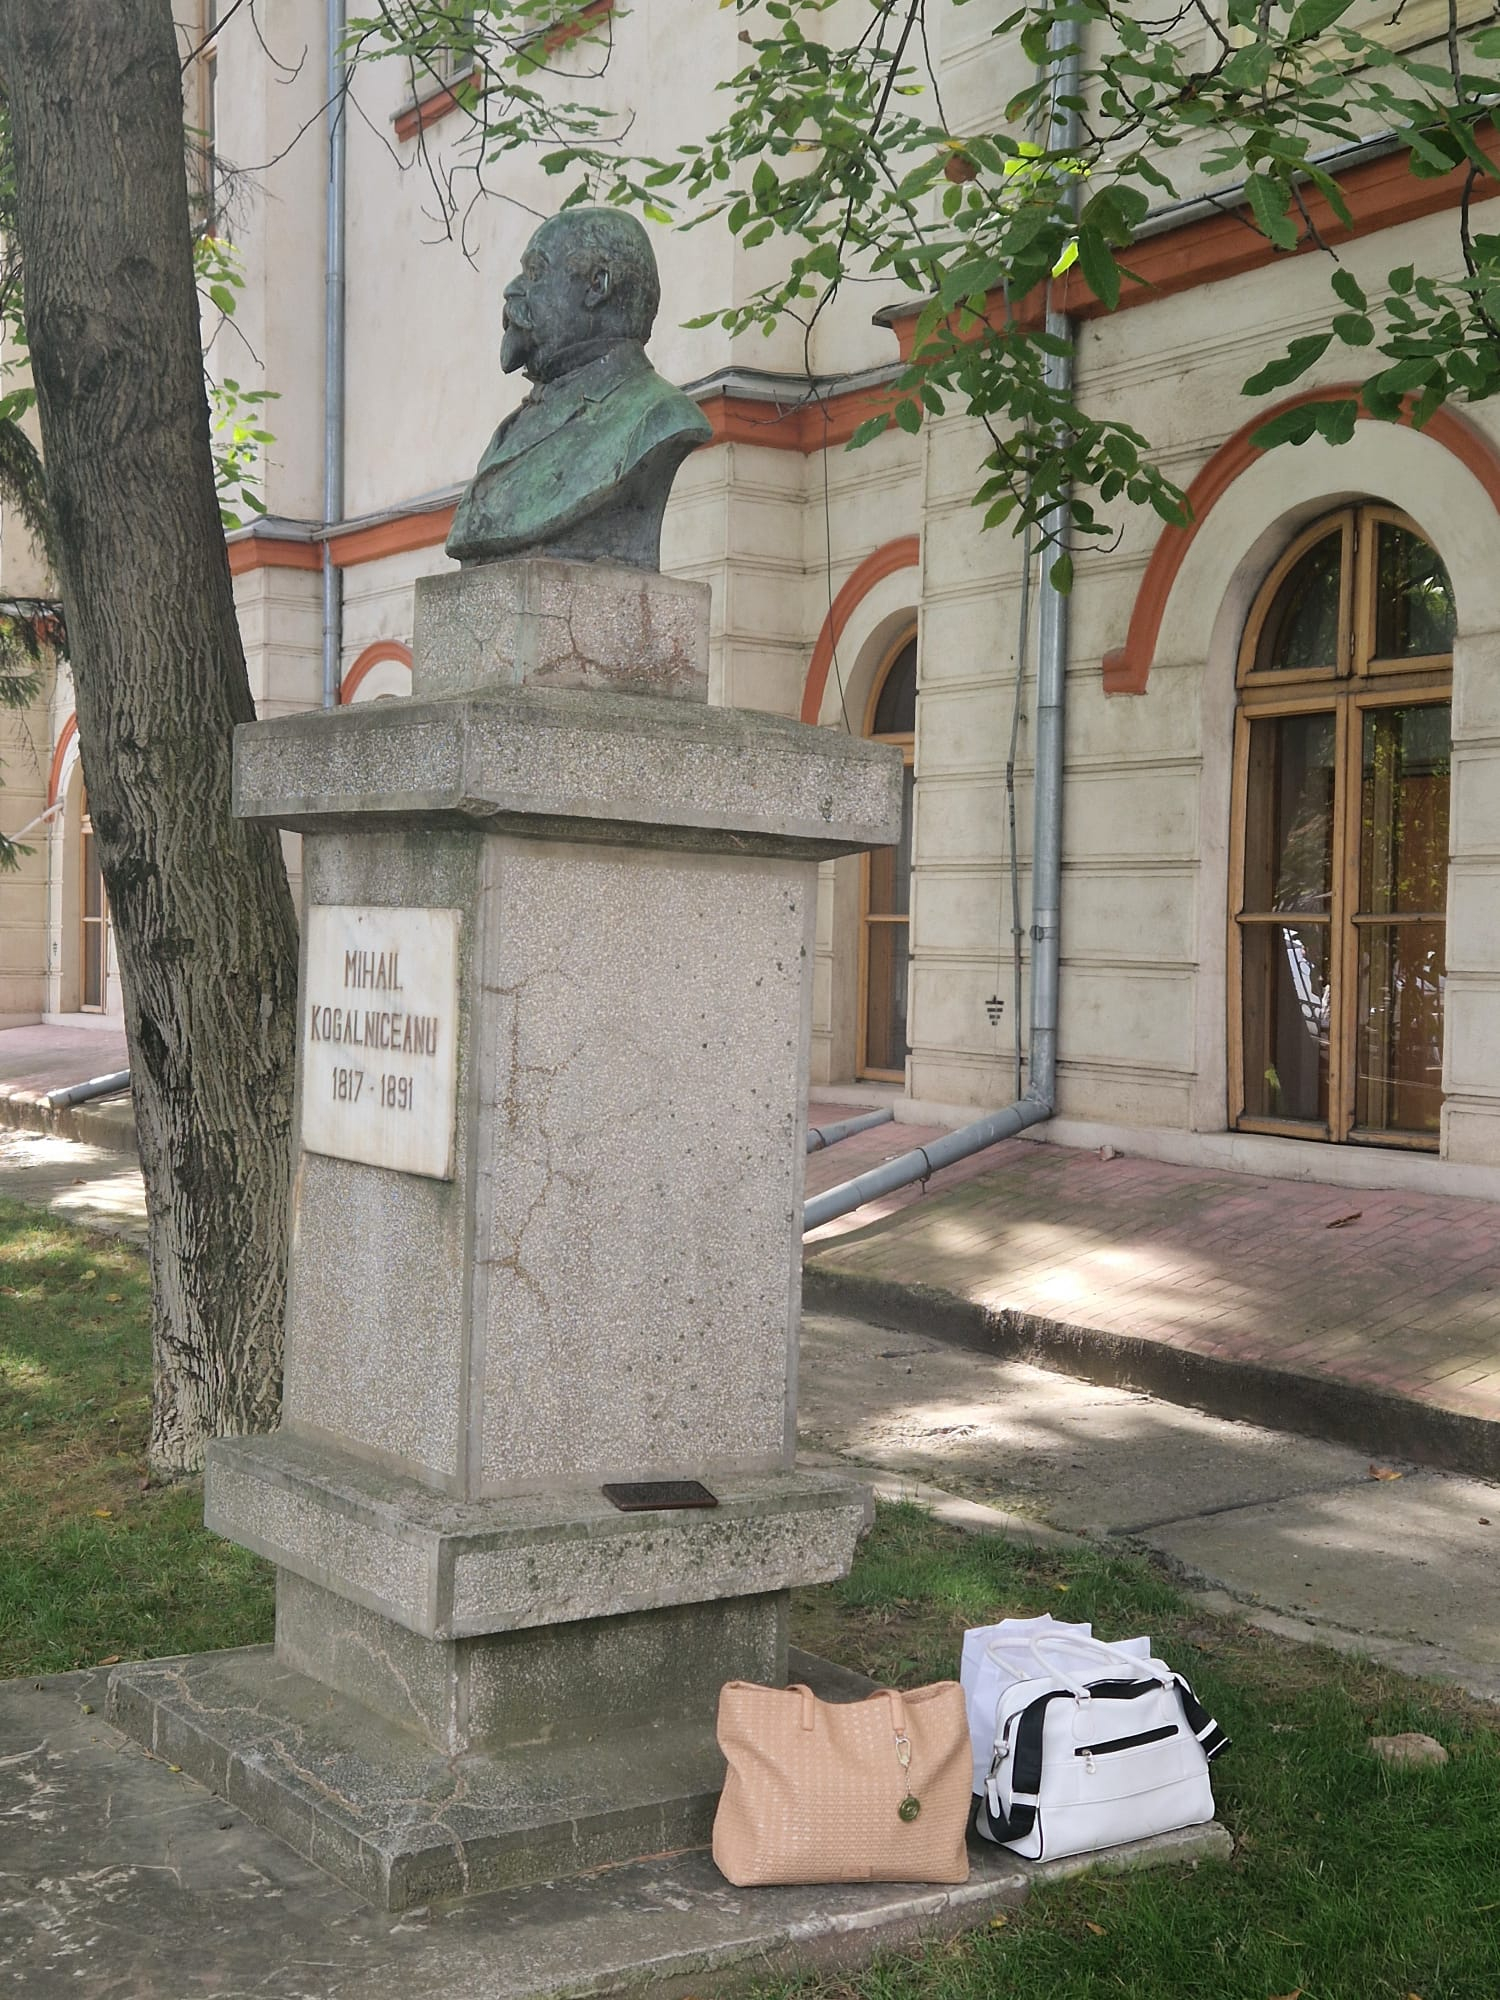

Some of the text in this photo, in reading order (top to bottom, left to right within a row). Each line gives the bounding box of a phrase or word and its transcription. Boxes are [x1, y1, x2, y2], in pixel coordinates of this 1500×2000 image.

[344, 950, 403, 991] MIHAIL
[311, 1005, 438, 1056] KOGALNICEANU
[332, 1067, 364, 1103] 1817
[380, 1073, 413, 1111] 1891
